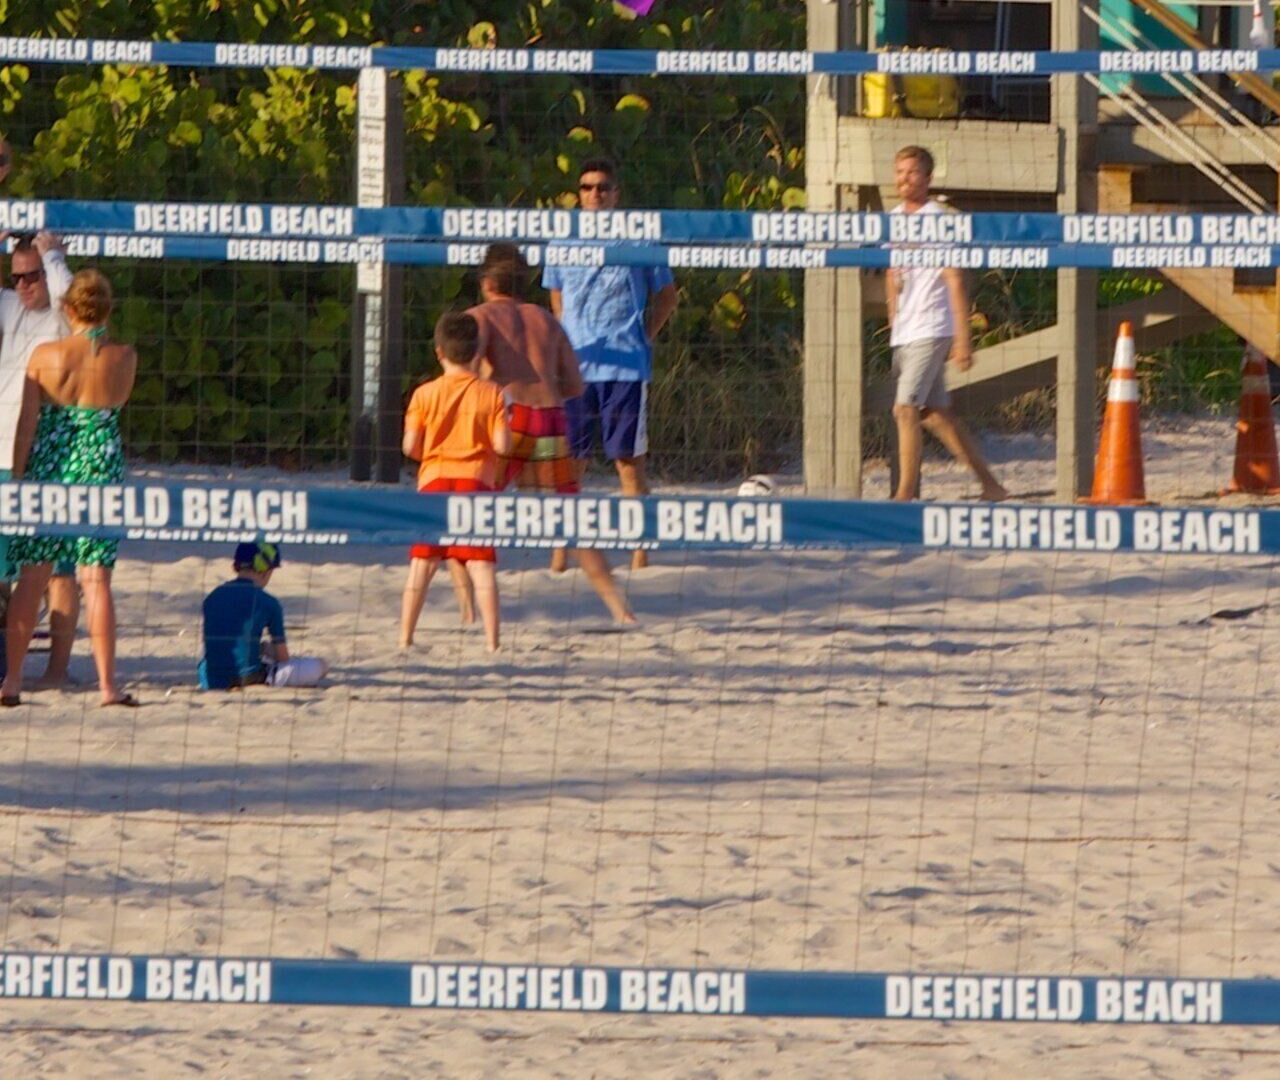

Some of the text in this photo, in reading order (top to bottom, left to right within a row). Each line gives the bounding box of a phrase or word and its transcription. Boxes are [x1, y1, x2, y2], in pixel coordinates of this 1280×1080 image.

[91, 40, 153, 62] BEACH
[215, 43, 373, 69] DEERFIELD BEACH
[435, 48, 593, 72] DEERFIELD BEACH
[656, 51, 814, 73] DEERFIELD BEACH
[877, 51, 1036, 74] DEERFIELD BEACH
[1099, 49, 1258, 73] DEERFIELD BEACH
[134, 203, 353, 236] DEERFIELD BEACH
[443, 209, 661, 240] DEERFIELD BEACH
[752, 211, 972, 244] DEERFIELD BEACH
[1063, 214, 1194, 245] DEERFIELD
[102, 235, 164, 258] BEACH
[226, 239, 384, 265] DEERFIELD BEACH
[544, 245, 605, 268] BEACH
[667, 245, 826, 268] DEERFIELD BEACH
[889, 246, 1049, 269] DEERFIELD BEACH
[1112, 245, 1272, 268] DEERFIELD BEACH
[182, 488, 308, 531] BEACH
[447, 495, 783, 543] DEERFIELD BEACH
[923, 506, 1260, 553] DEERFIELD BEACH
[146, 959, 272, 1001] BEACH
[410, 965, 747, 1013] DEERFIELD BEACH
[885, 975, 1223, 1023] DEERFIELD BEACH
